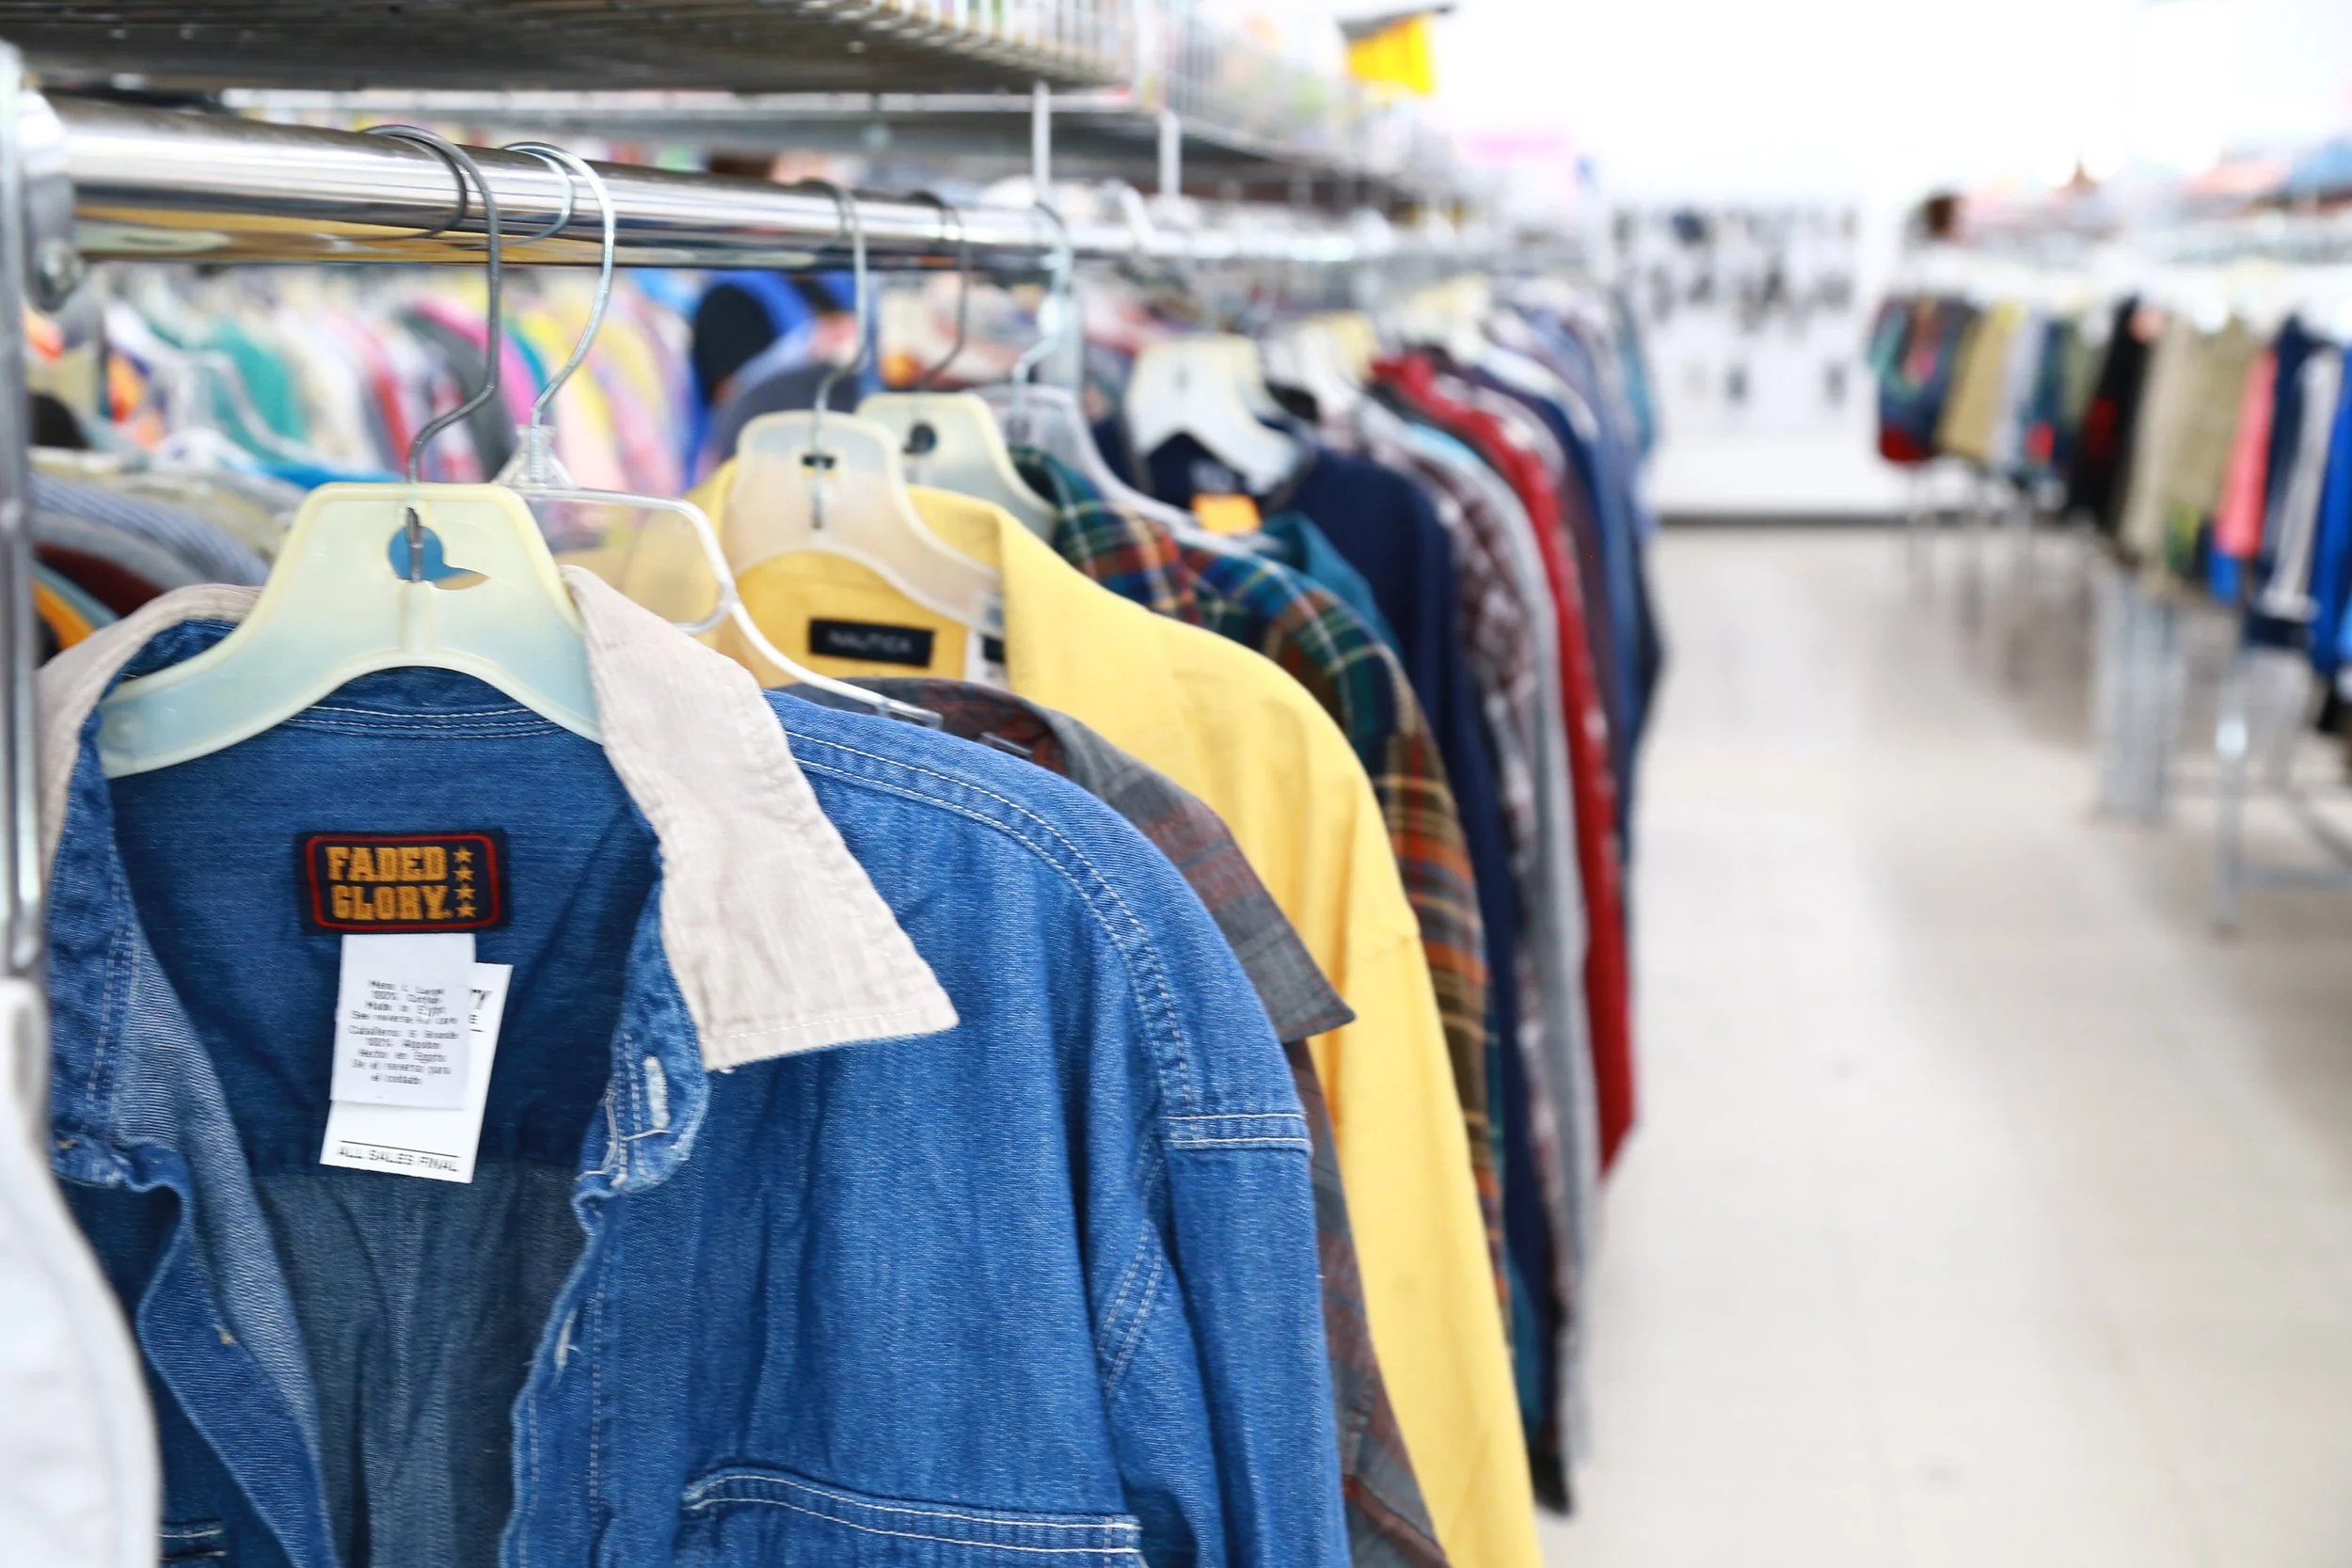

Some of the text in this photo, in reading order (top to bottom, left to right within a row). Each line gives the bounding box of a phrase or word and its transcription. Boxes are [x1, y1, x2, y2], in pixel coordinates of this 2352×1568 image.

[828, 629, 914, 654] NAUTICA
[325, 846, 448, 881] FADED
[338, 1147, 459, 1172] ALL SALES FINAL
